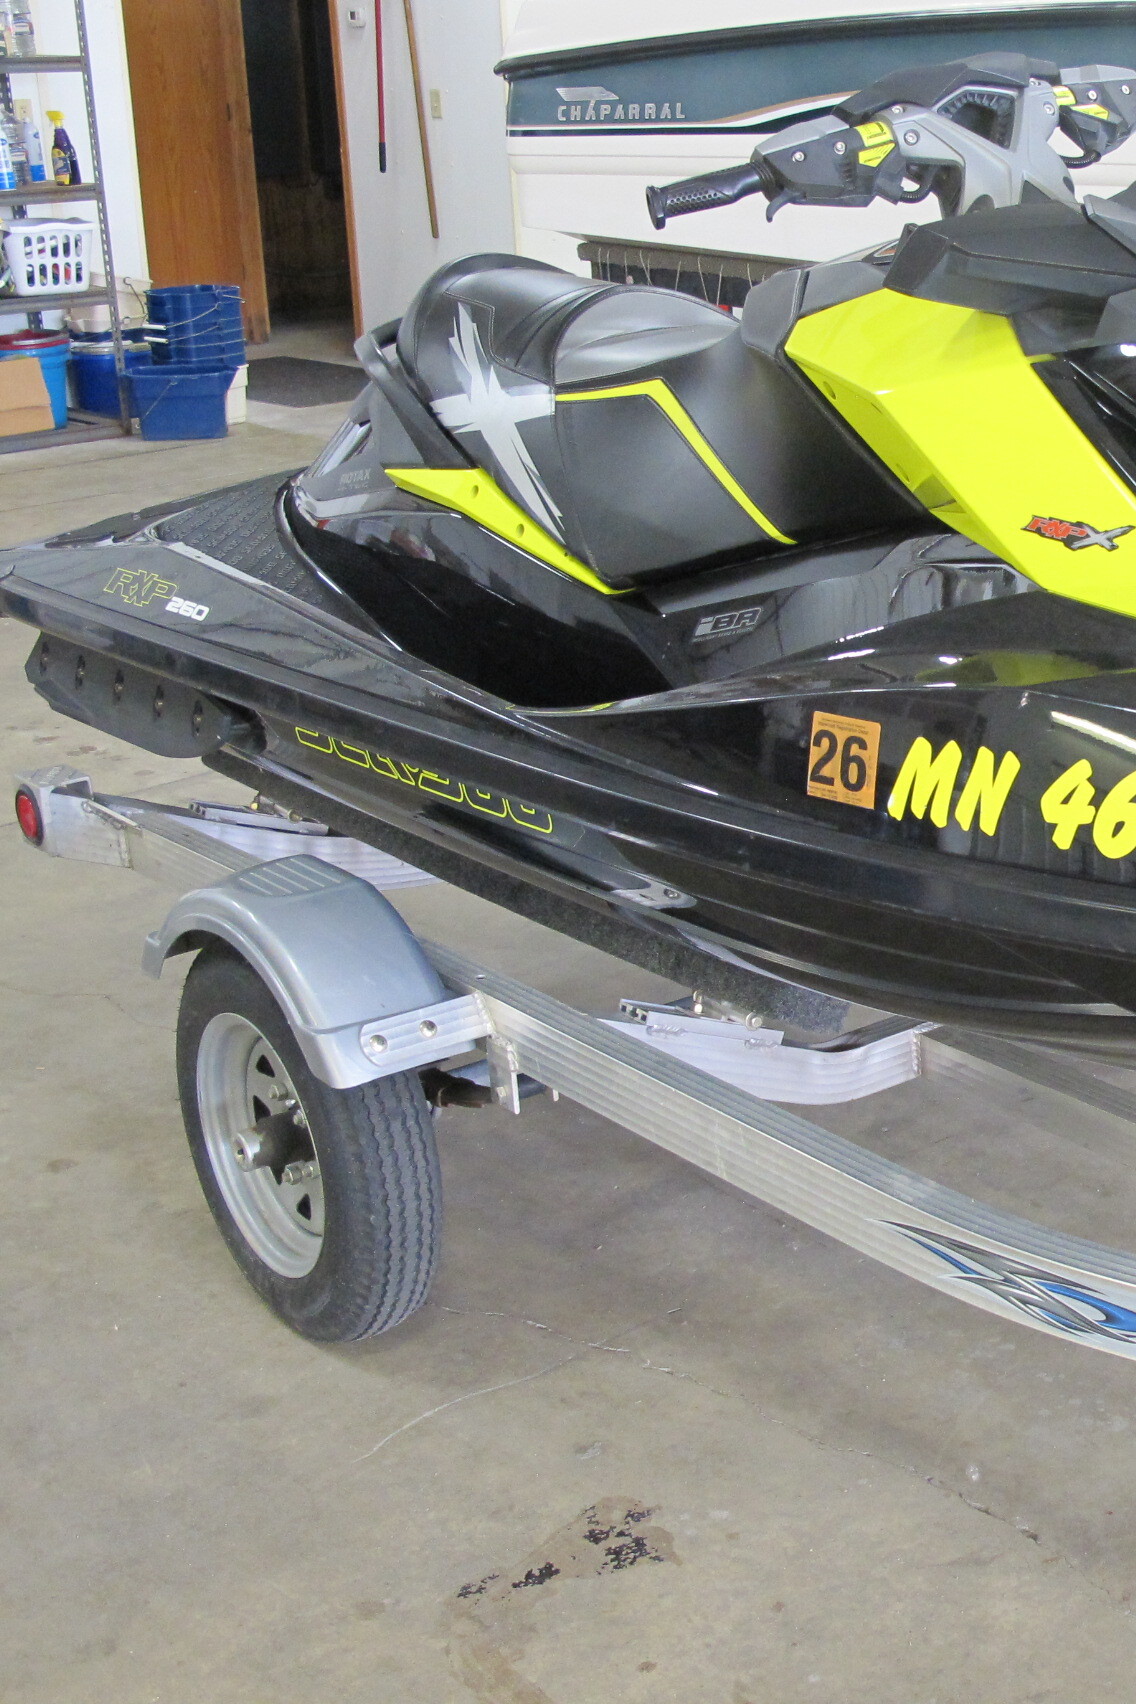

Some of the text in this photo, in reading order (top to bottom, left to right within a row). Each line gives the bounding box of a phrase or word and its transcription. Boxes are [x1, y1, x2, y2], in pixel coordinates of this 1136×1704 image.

[557, 100, 686, 121] CHAPARRAL
[165, 596, 210, 622] 260
[810, 729, 868, 792] 26
[887, 737, 1020, 836] MN
